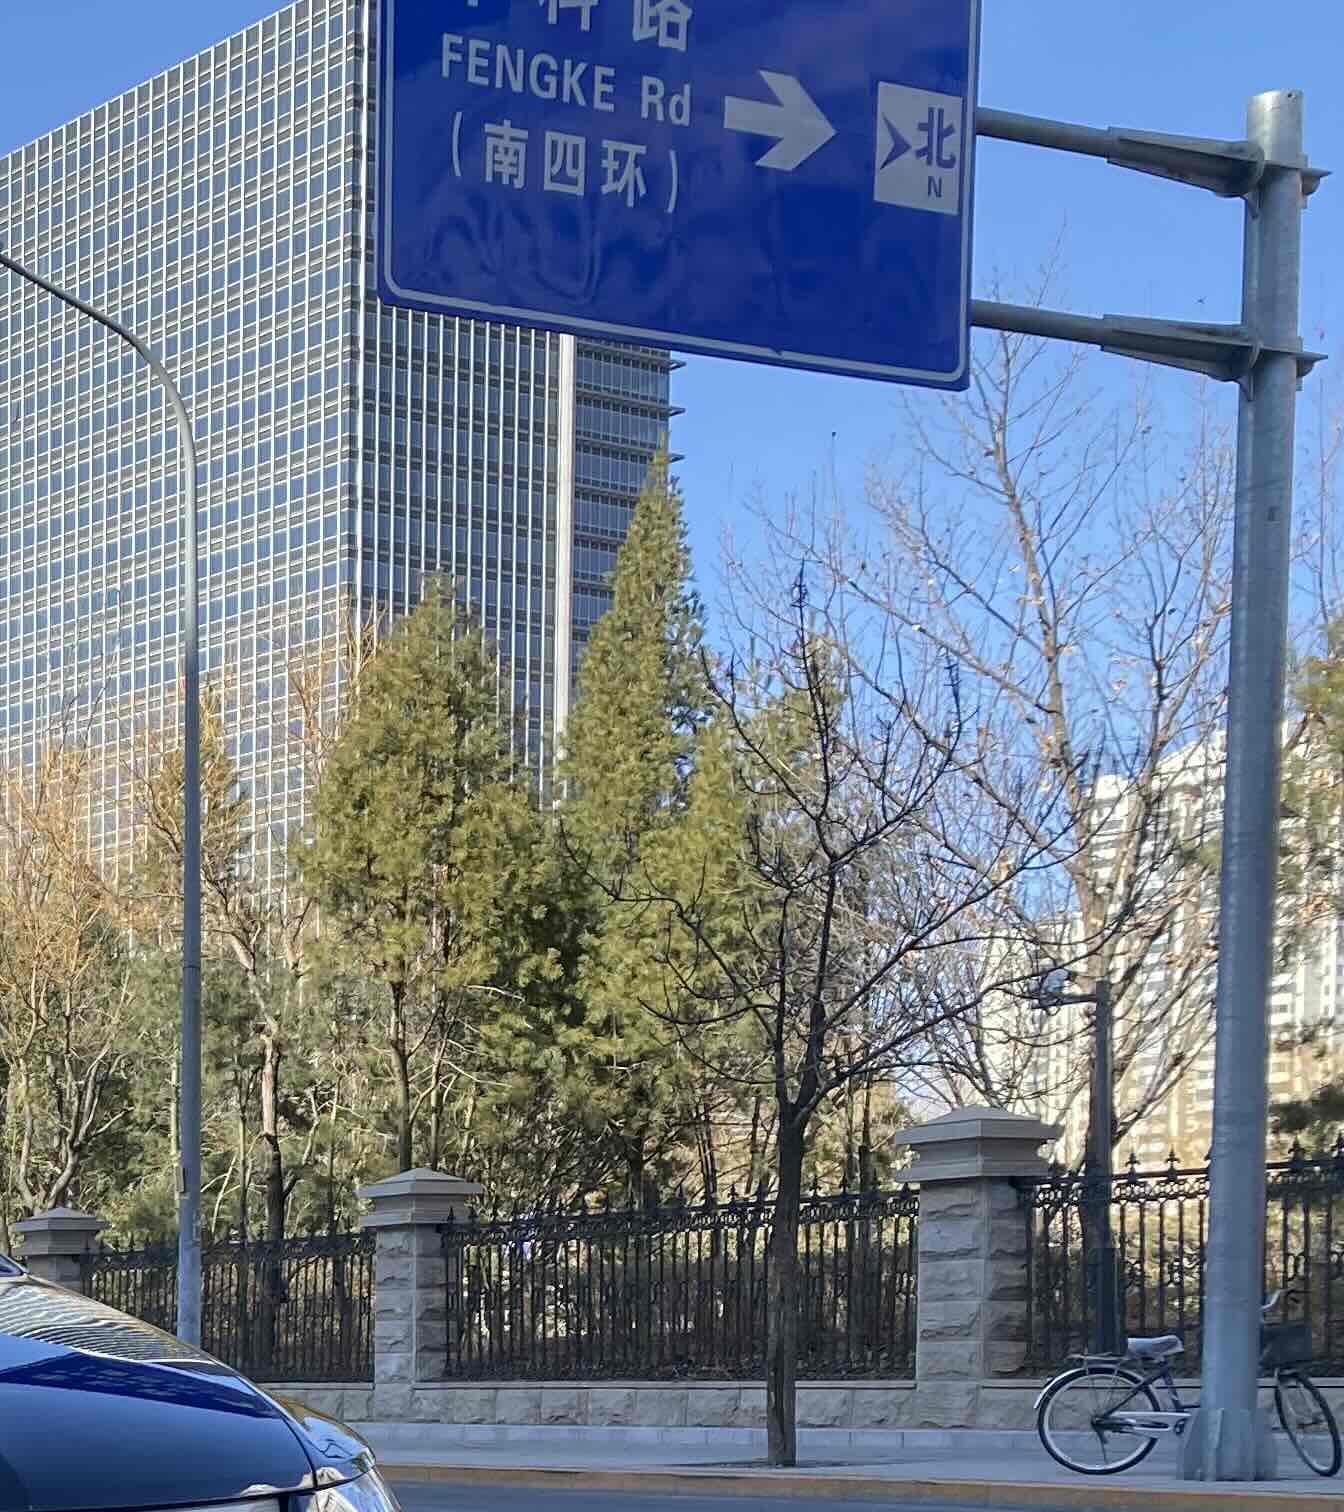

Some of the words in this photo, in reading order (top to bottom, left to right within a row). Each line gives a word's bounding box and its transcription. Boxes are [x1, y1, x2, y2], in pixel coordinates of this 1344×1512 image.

[441, 32, 615, 113] FENGKE
[640, 75, 691, 127] Rd
[914, 106, 956, 169] 北
[927, 175, 943, 198] N
